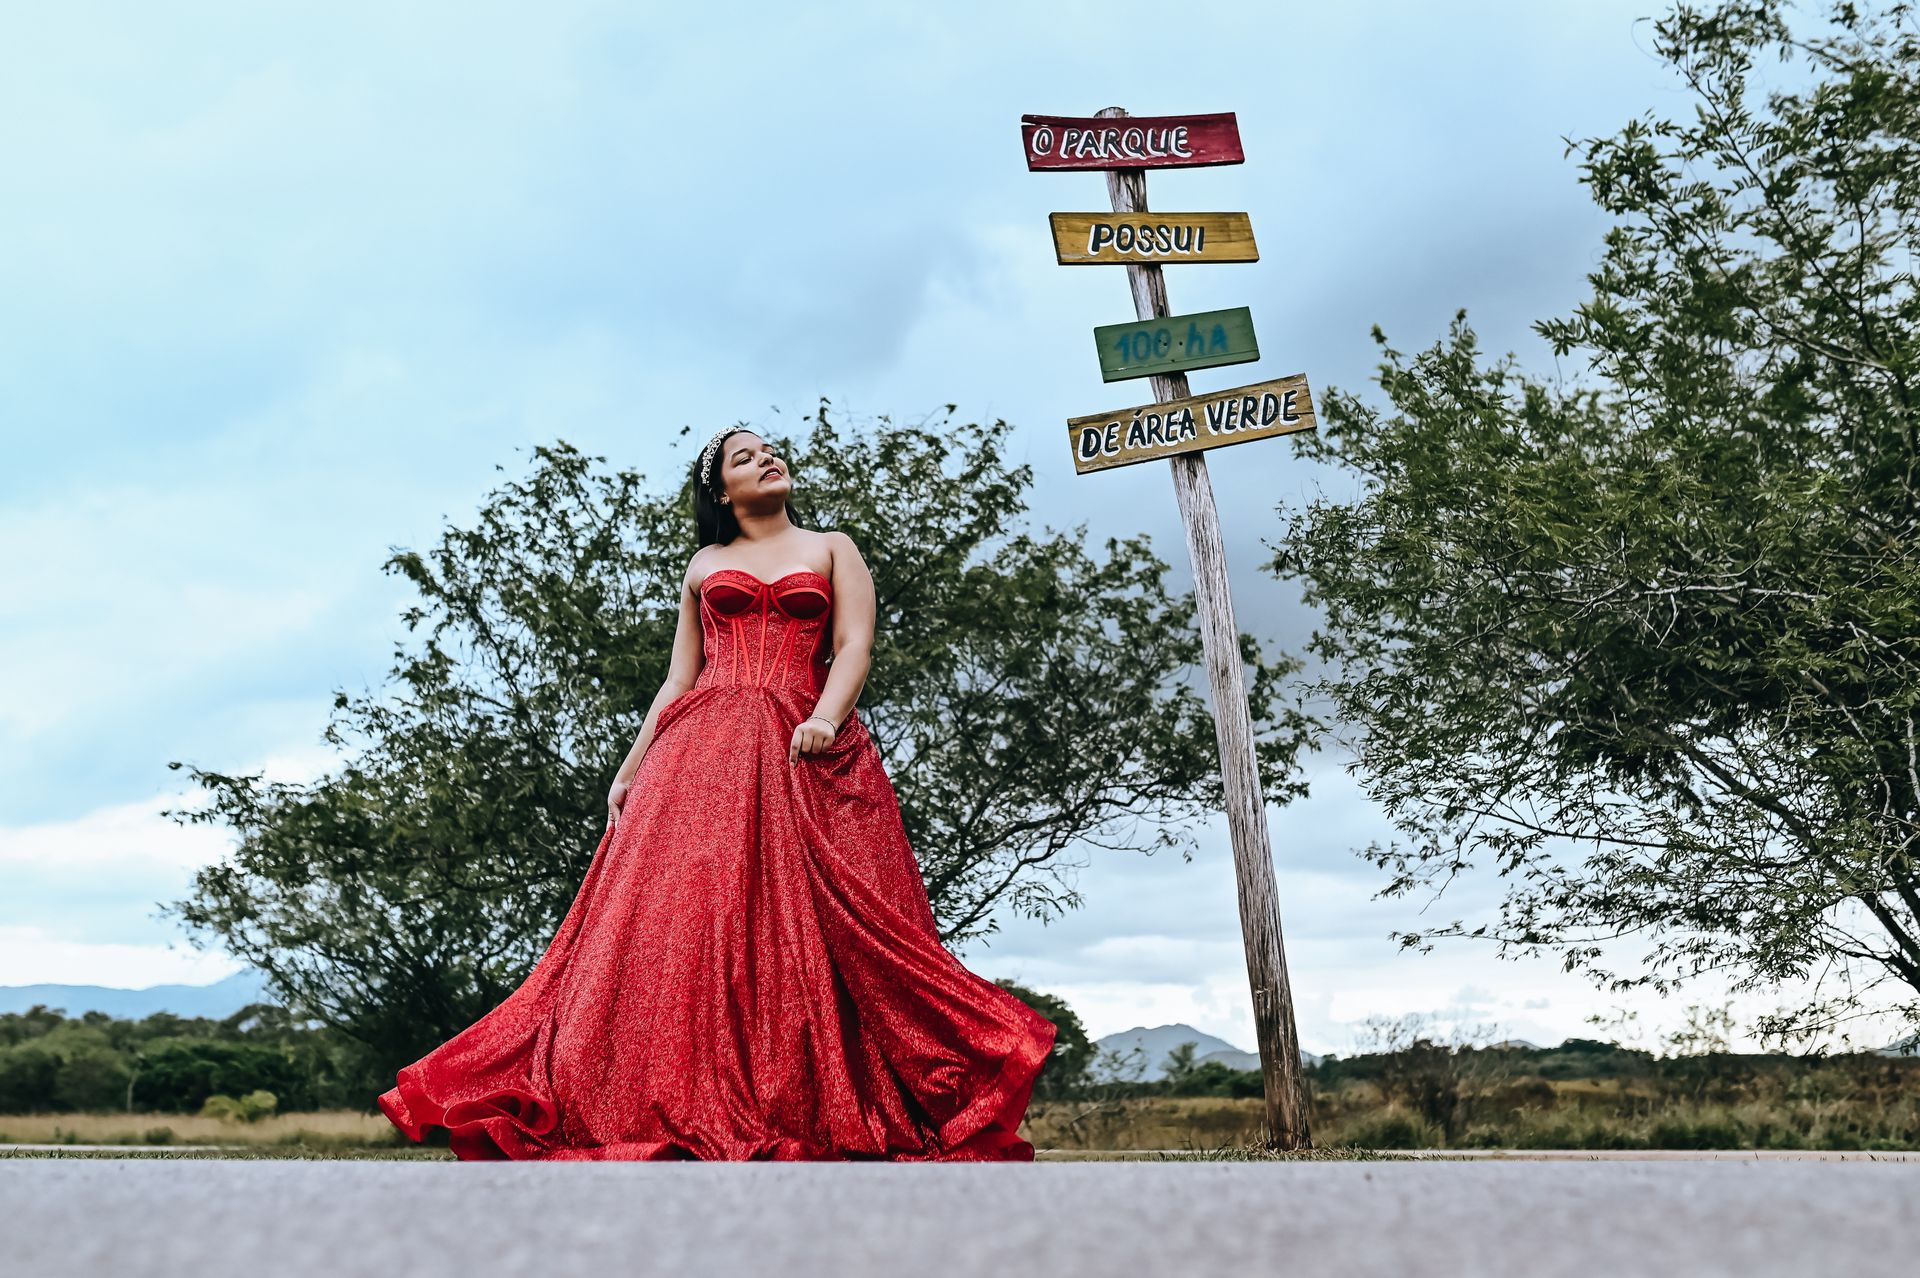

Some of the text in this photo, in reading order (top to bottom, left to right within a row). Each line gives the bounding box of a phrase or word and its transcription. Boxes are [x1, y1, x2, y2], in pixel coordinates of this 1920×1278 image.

[1032, 126, 1192, 160] O PARQUE
[1087, 223, 1205, 256] POSSUI
[1114, 328, 1171, 364] 100
[1078, 389, 1300, 462] DE ÁREA VERDE
